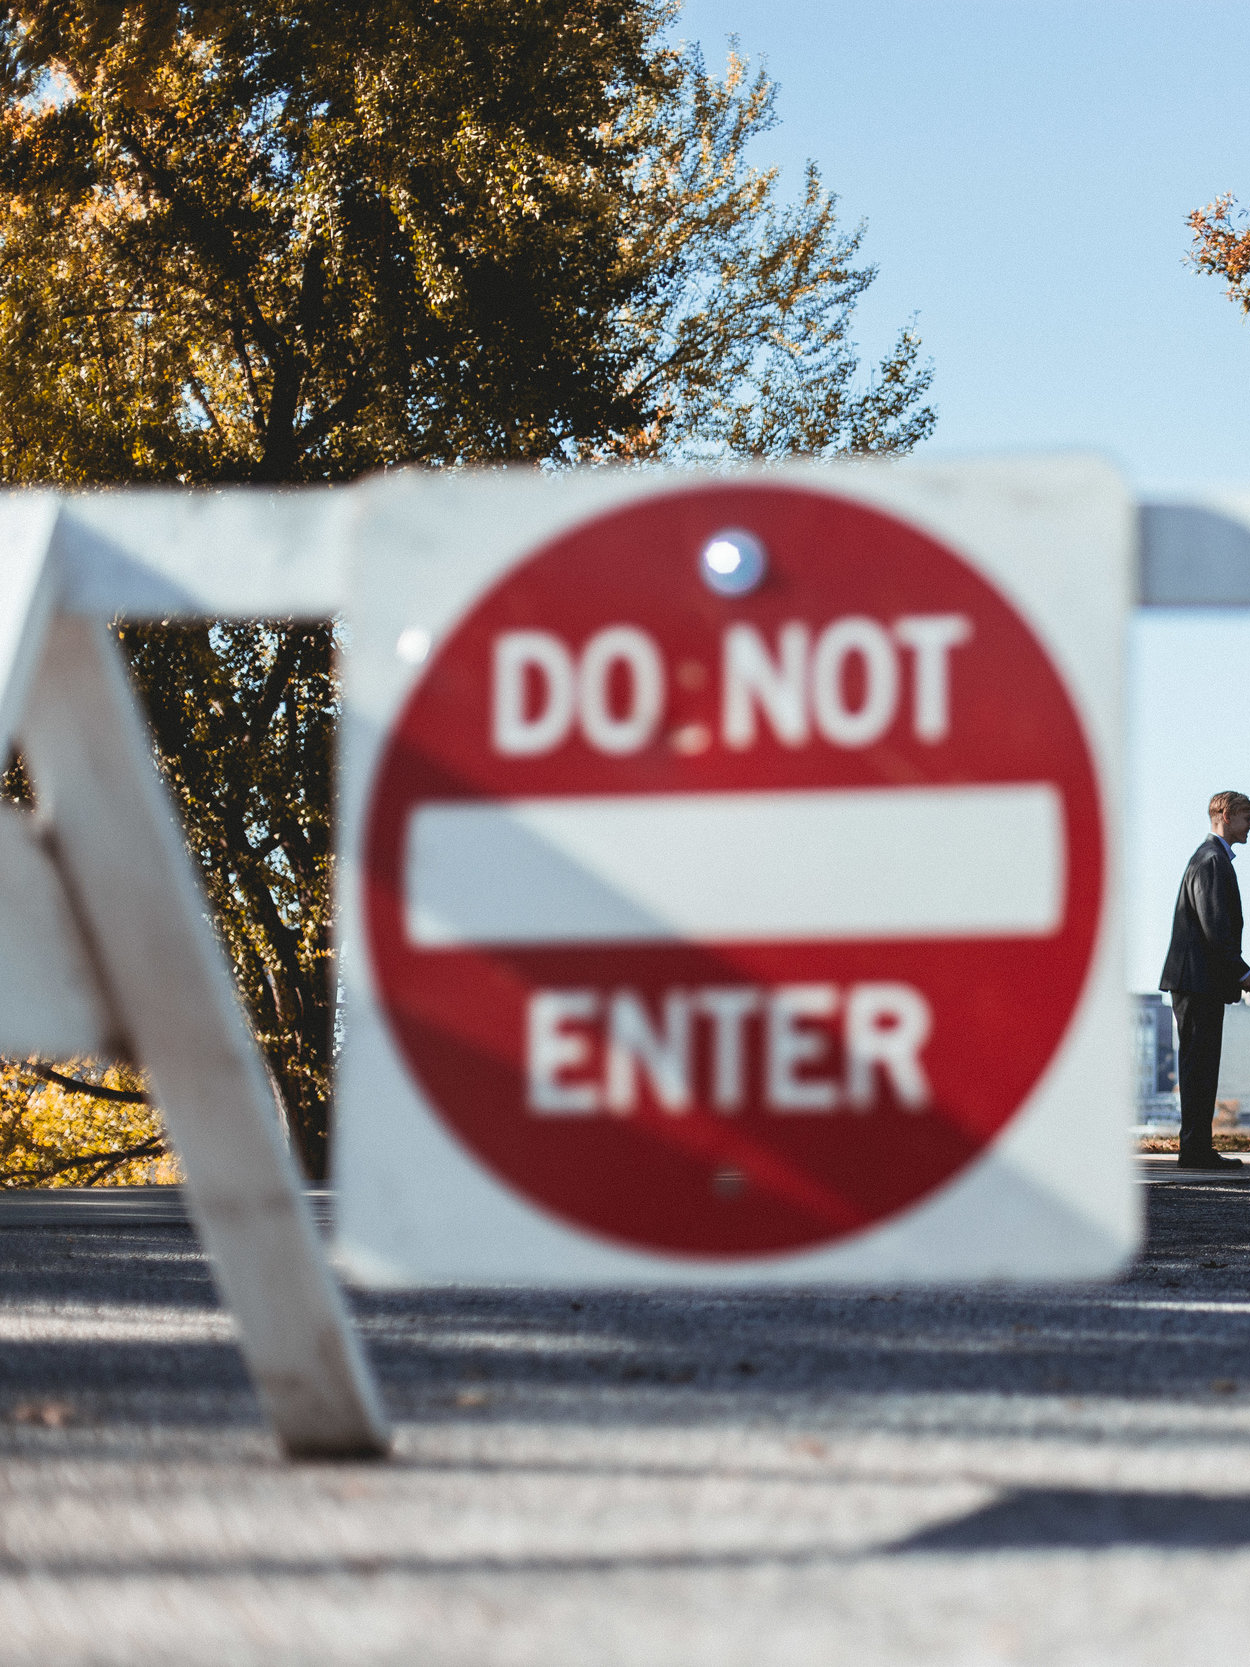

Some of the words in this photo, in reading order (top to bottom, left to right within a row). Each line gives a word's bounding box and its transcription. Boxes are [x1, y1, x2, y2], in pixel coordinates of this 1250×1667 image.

[491, 624, 667, 759] DO
[722, 614, 971, 751] NOT
[527, 983, 932, 1116] ENTER
